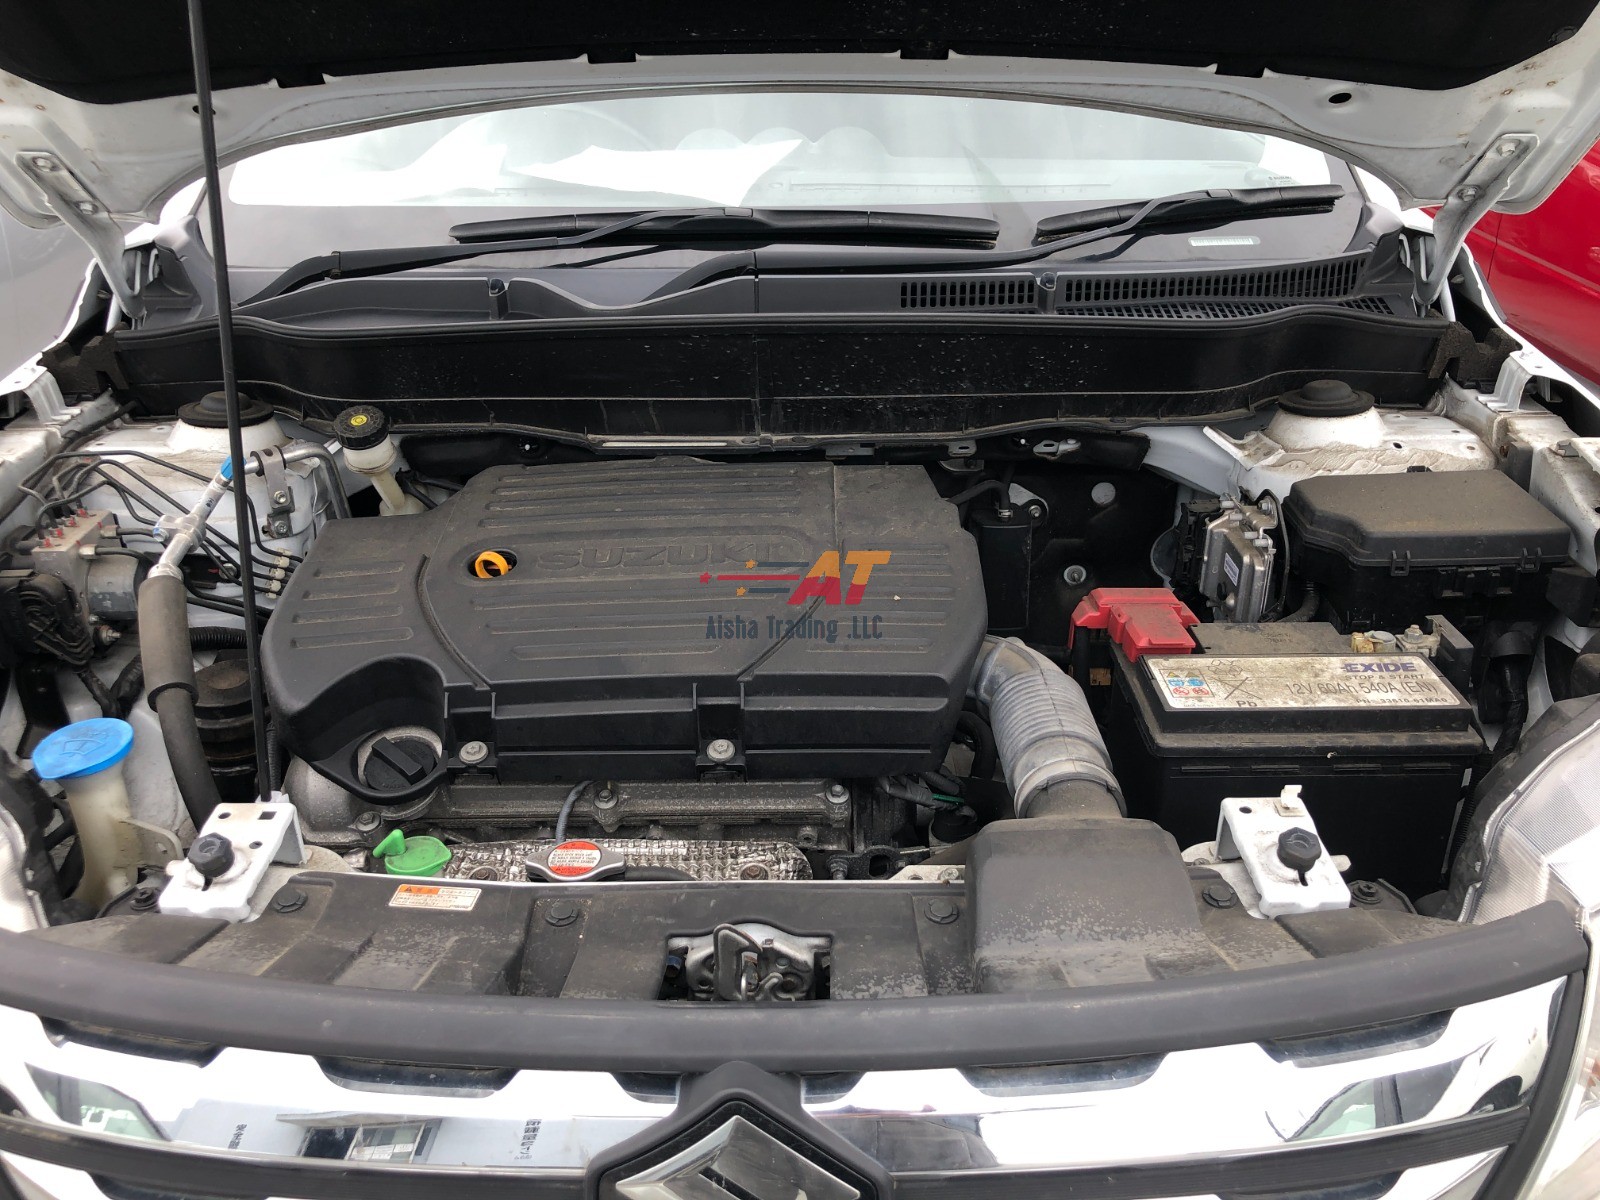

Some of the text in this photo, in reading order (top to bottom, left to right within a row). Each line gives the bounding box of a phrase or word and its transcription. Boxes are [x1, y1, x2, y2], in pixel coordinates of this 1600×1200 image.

[1343, 662, 1418, 673] EXIDE
[1285, 681, 1439, 695] 12V 60Ah 540A (EN)
[1235, 700, 1258, 708] Pb
